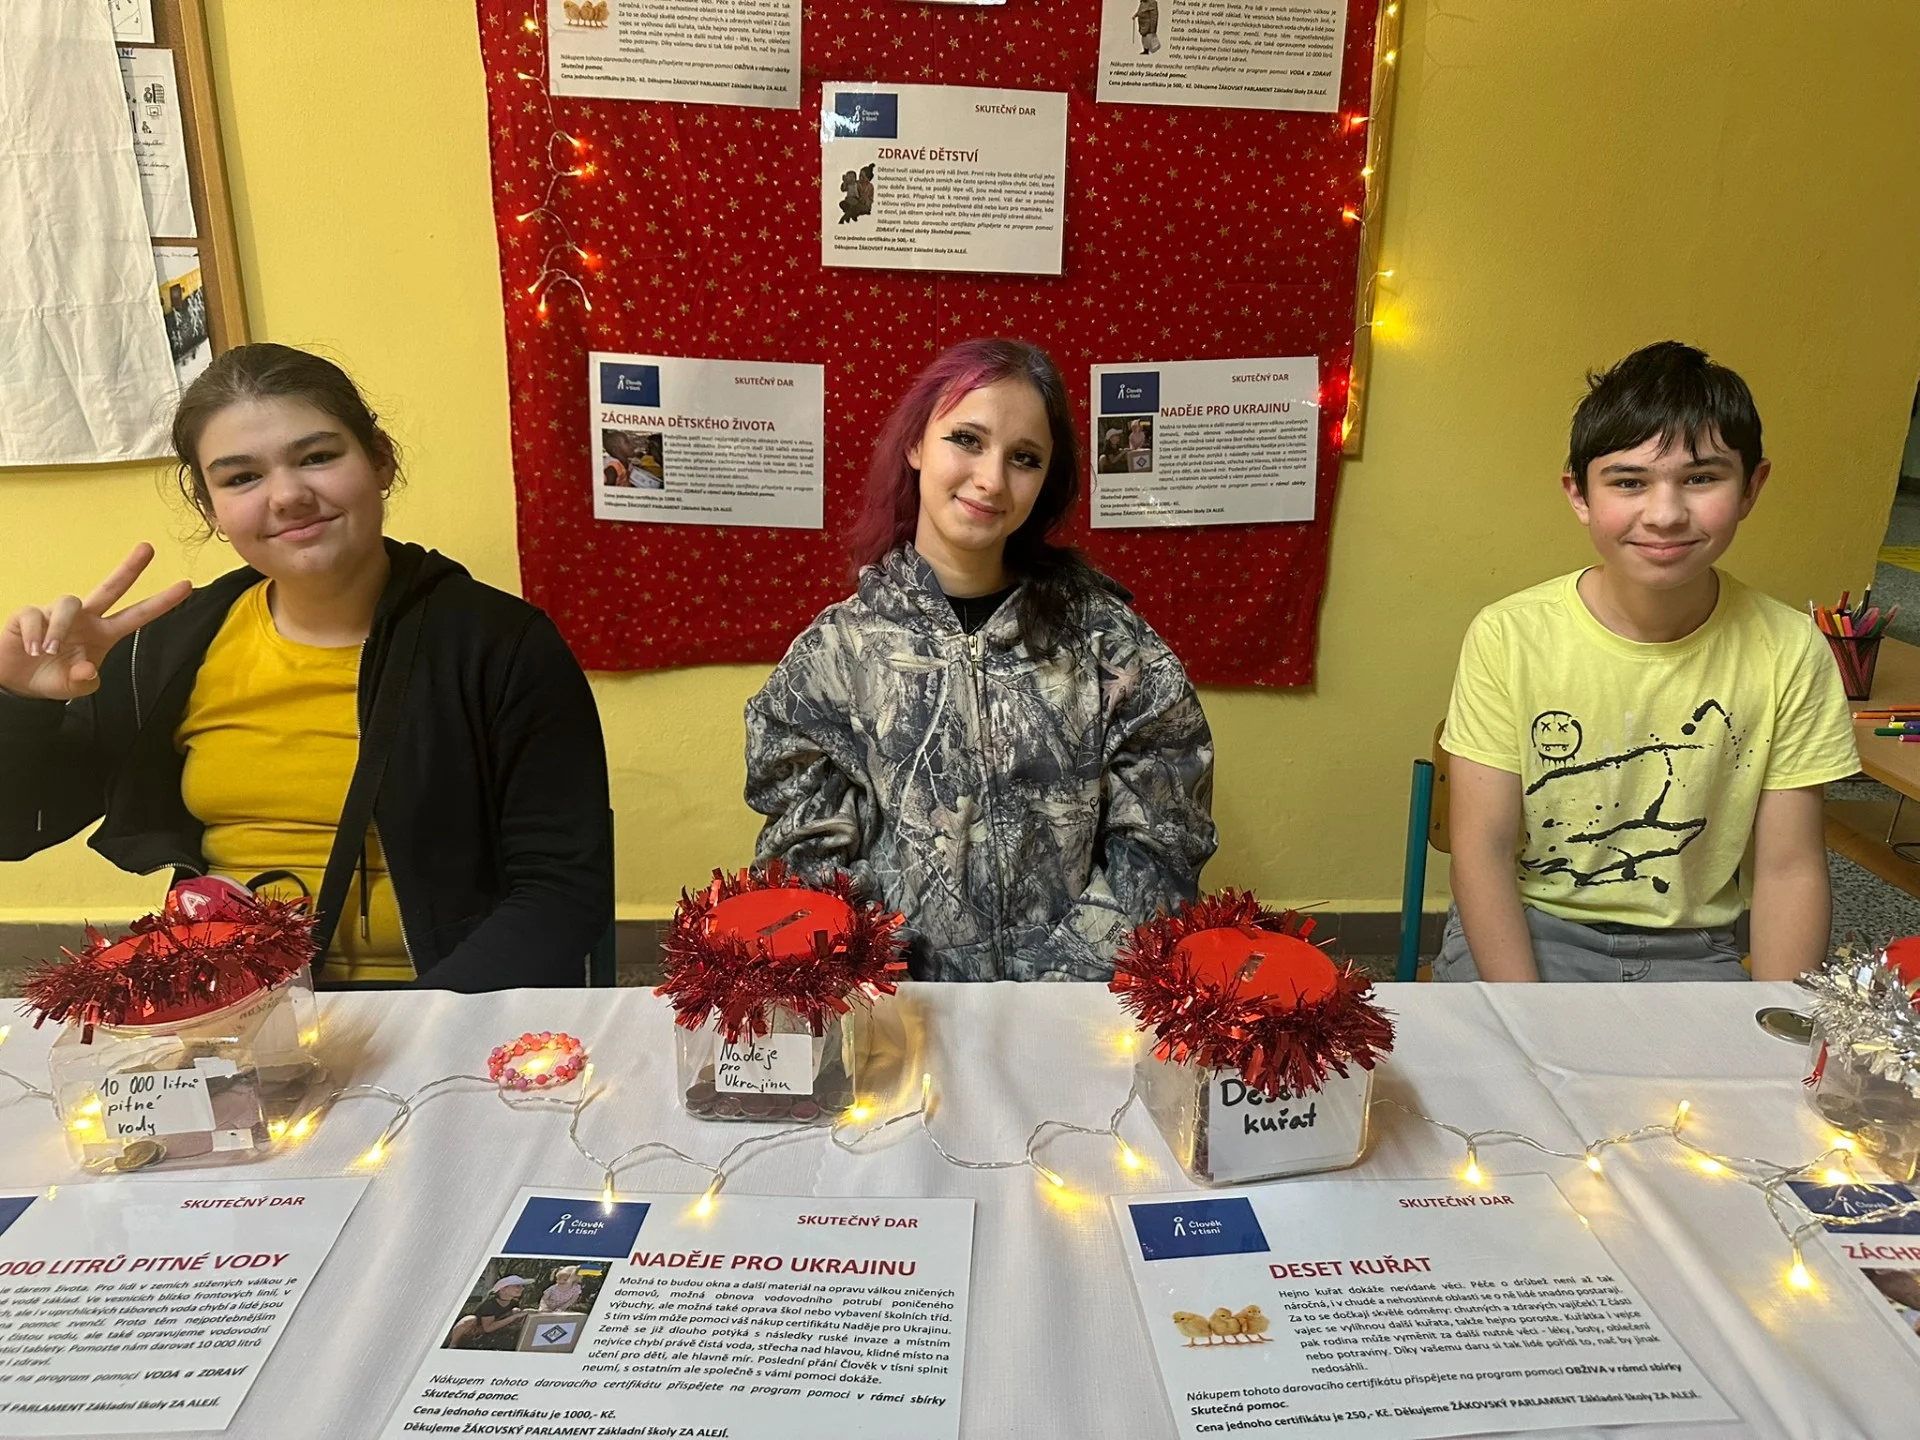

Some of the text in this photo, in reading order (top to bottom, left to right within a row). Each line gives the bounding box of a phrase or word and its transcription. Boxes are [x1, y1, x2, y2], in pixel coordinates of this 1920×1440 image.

[975, 104, 1035, 115] SKUTEČNÝ DAR
[877, 146, 978, 162] ZDRAVÉ DĚTSTVÍ
[734, 376, 793, 386] SKUTEČNÝ DAR
[1231, 372, 1288, 382] SKUTEČNÝ DAR
[1160, 402, 1290, 417] NADĚJE PRO UKRAJINU
[601, 410, 775, 431] ZÁCHRANA DĚTSKÉHO ŽIVOTA
[719, 1063, 740, 1075] pro
[101, 1076, 119, 1097] 10
[129, 1075, 155, 1092] 000
[725, 1074, 791, 1093] Ukrajinu
[108, 1094, 162, 1116] pitné
[118, 1116, 156, 1136] vody
[1245, 1102, 1317, 1135] kuřat
[180, 1195, 305, 1208] SKUTEČNÝ DAR
[1398, 1194, 1514, 1208] SKUTEČNÝ DAR
[571, 1219, 604, 1229] Člověk
[797, 1214, 917, 1228] SKUTEČNÝ DAR
[1188, 1220, 1223, 1228] Člověk
[1198, 1227, 1221, 1235] tísni
[47, 1254, 127, 1274] LITRŮ
[127, 1252, 210, 1272] PITNÉ
[214, 1253, 289, 1269] VODY
[629, 1250, 915, 1275] NADĚJE PRO UKRAJINU
[1268, 1254, 1431, 1279] DESET KUŘAT
[619, 1277, 654, 1285] Možná
[669, 1278, 703, 1286] budou
[705, 1279, 730, 1287] okna
[741, 1281, 766, 1289] další
[767, 1283, 811, 1291] materiál
[867, 1286, 901, 1294] válkou
[903, 1287, 954, 1298] zničených
[1278, 1289, 1309, 1298] Hejno
[1314, 1287, 1343, 1295] kuřat
[1348, 1285, 1384, 1294] dokáže
[1389, 1282, 1436, 1292] nevídané
[1441, 1281, 1465, 1289] věci.
[1470, 1280, 1495, 1288] Péče
[1513, 1277, 1548, 1286] drůbež
[1552, 1276, 1576, 1284] není
[1581, 1275, 1593, 1283] až
[1596, 1274, 1614, 1282] tak
[614, 1288, 953, 1309] domovů, možná obnova vodovodního potrubí poničeného
[609, 1300, 952, 1321] výbuchy, ale možná také oprava škol nebo vybavení školních tříd.
[612, 1312, 630, 1320] tím
[632, 1312, 656, 1320] vším
[658, 1313, 687, 1322] může
[731, 1316, 749, 1324] váš
[750, 1317, 784, 1327] nákup
[785, 1319, 840, 1329] certifikátu
[842, 1321, 880, 1332] Naděje
[903, 1324, 951, 1335] Ukrajinu.
[421, 1388, 518, 1401] Skutečná pomoc.
[413, 1405, 615, 1420] Cena jednoho certifikátu je 1000,- Kč.
[1190, 1401, 1288, 1415] Skutečná pomoc.
[403, 1422, 728, 1437] Děkujeme ŽÁKOVSKÝ PARLAMENT Základní školy ZA ALEJÍ.
